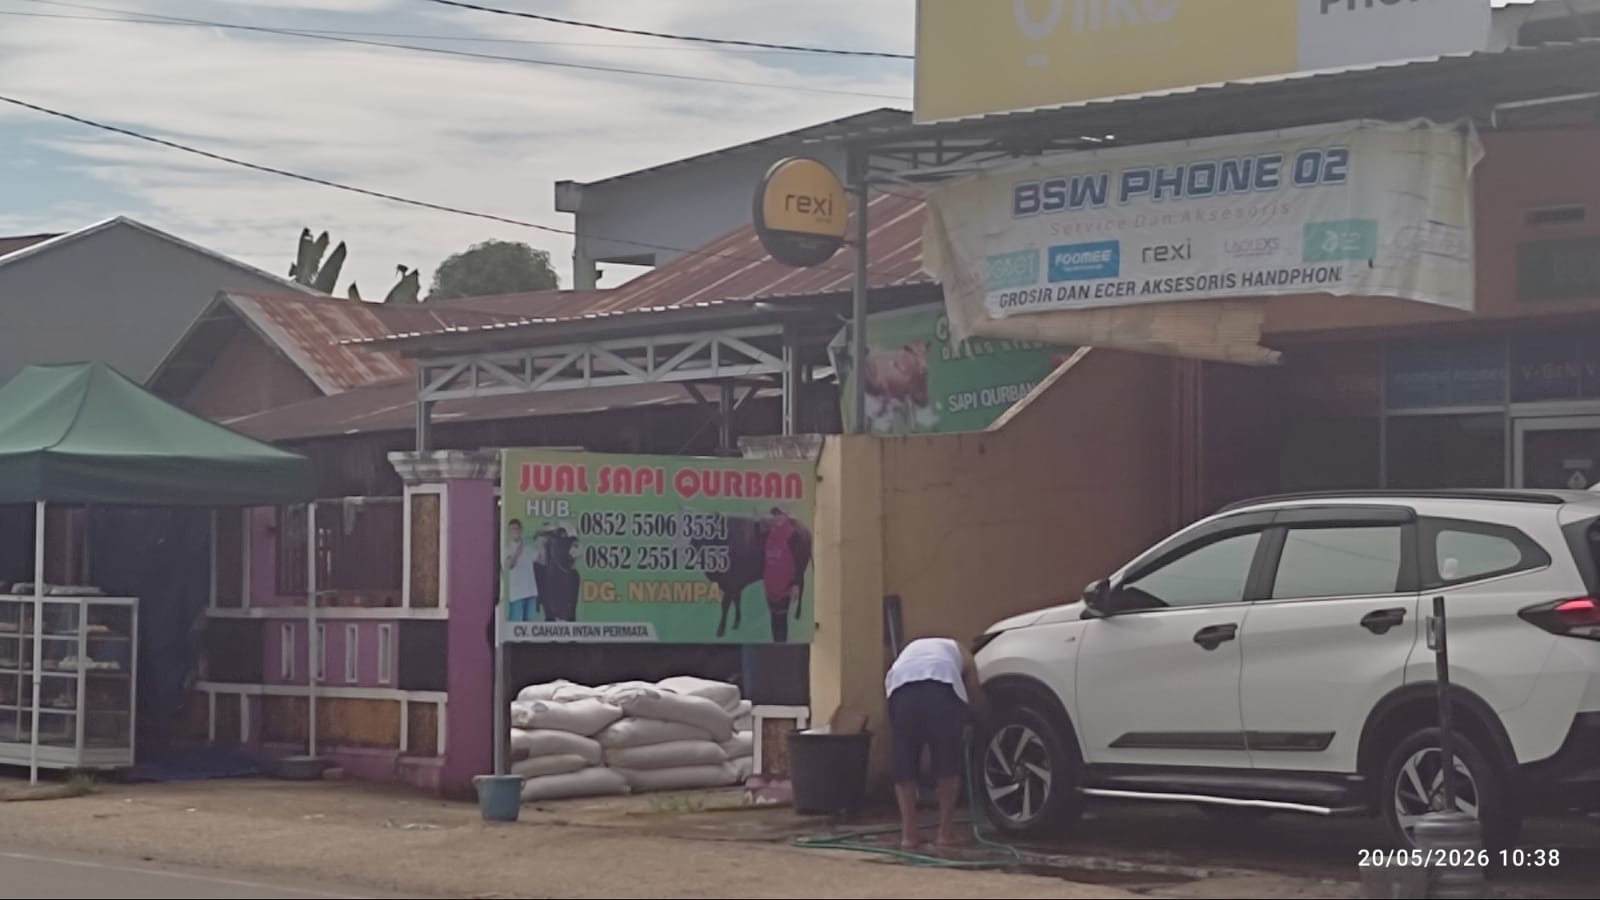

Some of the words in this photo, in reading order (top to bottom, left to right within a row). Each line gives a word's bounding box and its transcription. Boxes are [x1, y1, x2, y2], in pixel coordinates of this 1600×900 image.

[1013, 172, 1109, 218] BSW
[1119, 154, 1283, 204] PHONE
[785, 193, 833, 216] rexi
[1142, 237, 1192, 264] rexi
[1000, 288, 1052, 308] GROSIR
[1057, 284, 1090, 302] DAN
[1095, 281, 1136, 299] ECER
[1140, 272, 1237, 297] AKSESORIS
[1241, 266, 1343, 288] HANDPHON
[949, 391, 979, 413] SAPI
[519, 463, 589, 493] JUAL
[597, 466, 665, 496] SAPI
[673, 467, 804, 499] QURBAN
[580, 512, 627, 537] 0852
[632, 513, 677, 537] 5506
[682, 514, 728, 540] 3554
[585, 545, 632, 570] 0852
[637, 546, 678, 571] 2551
[684, 546, 731, 572] 2455
[583, 581, 621, 602] DG.
[628, 581, 723, 603] NYAMPA
[514, 625, 529, 637] CV.
[531, 625, 571, 637] CAHAYA
[572, 625, 600, 637] INTAN
[603, 625, 649, 637] PERMATA
